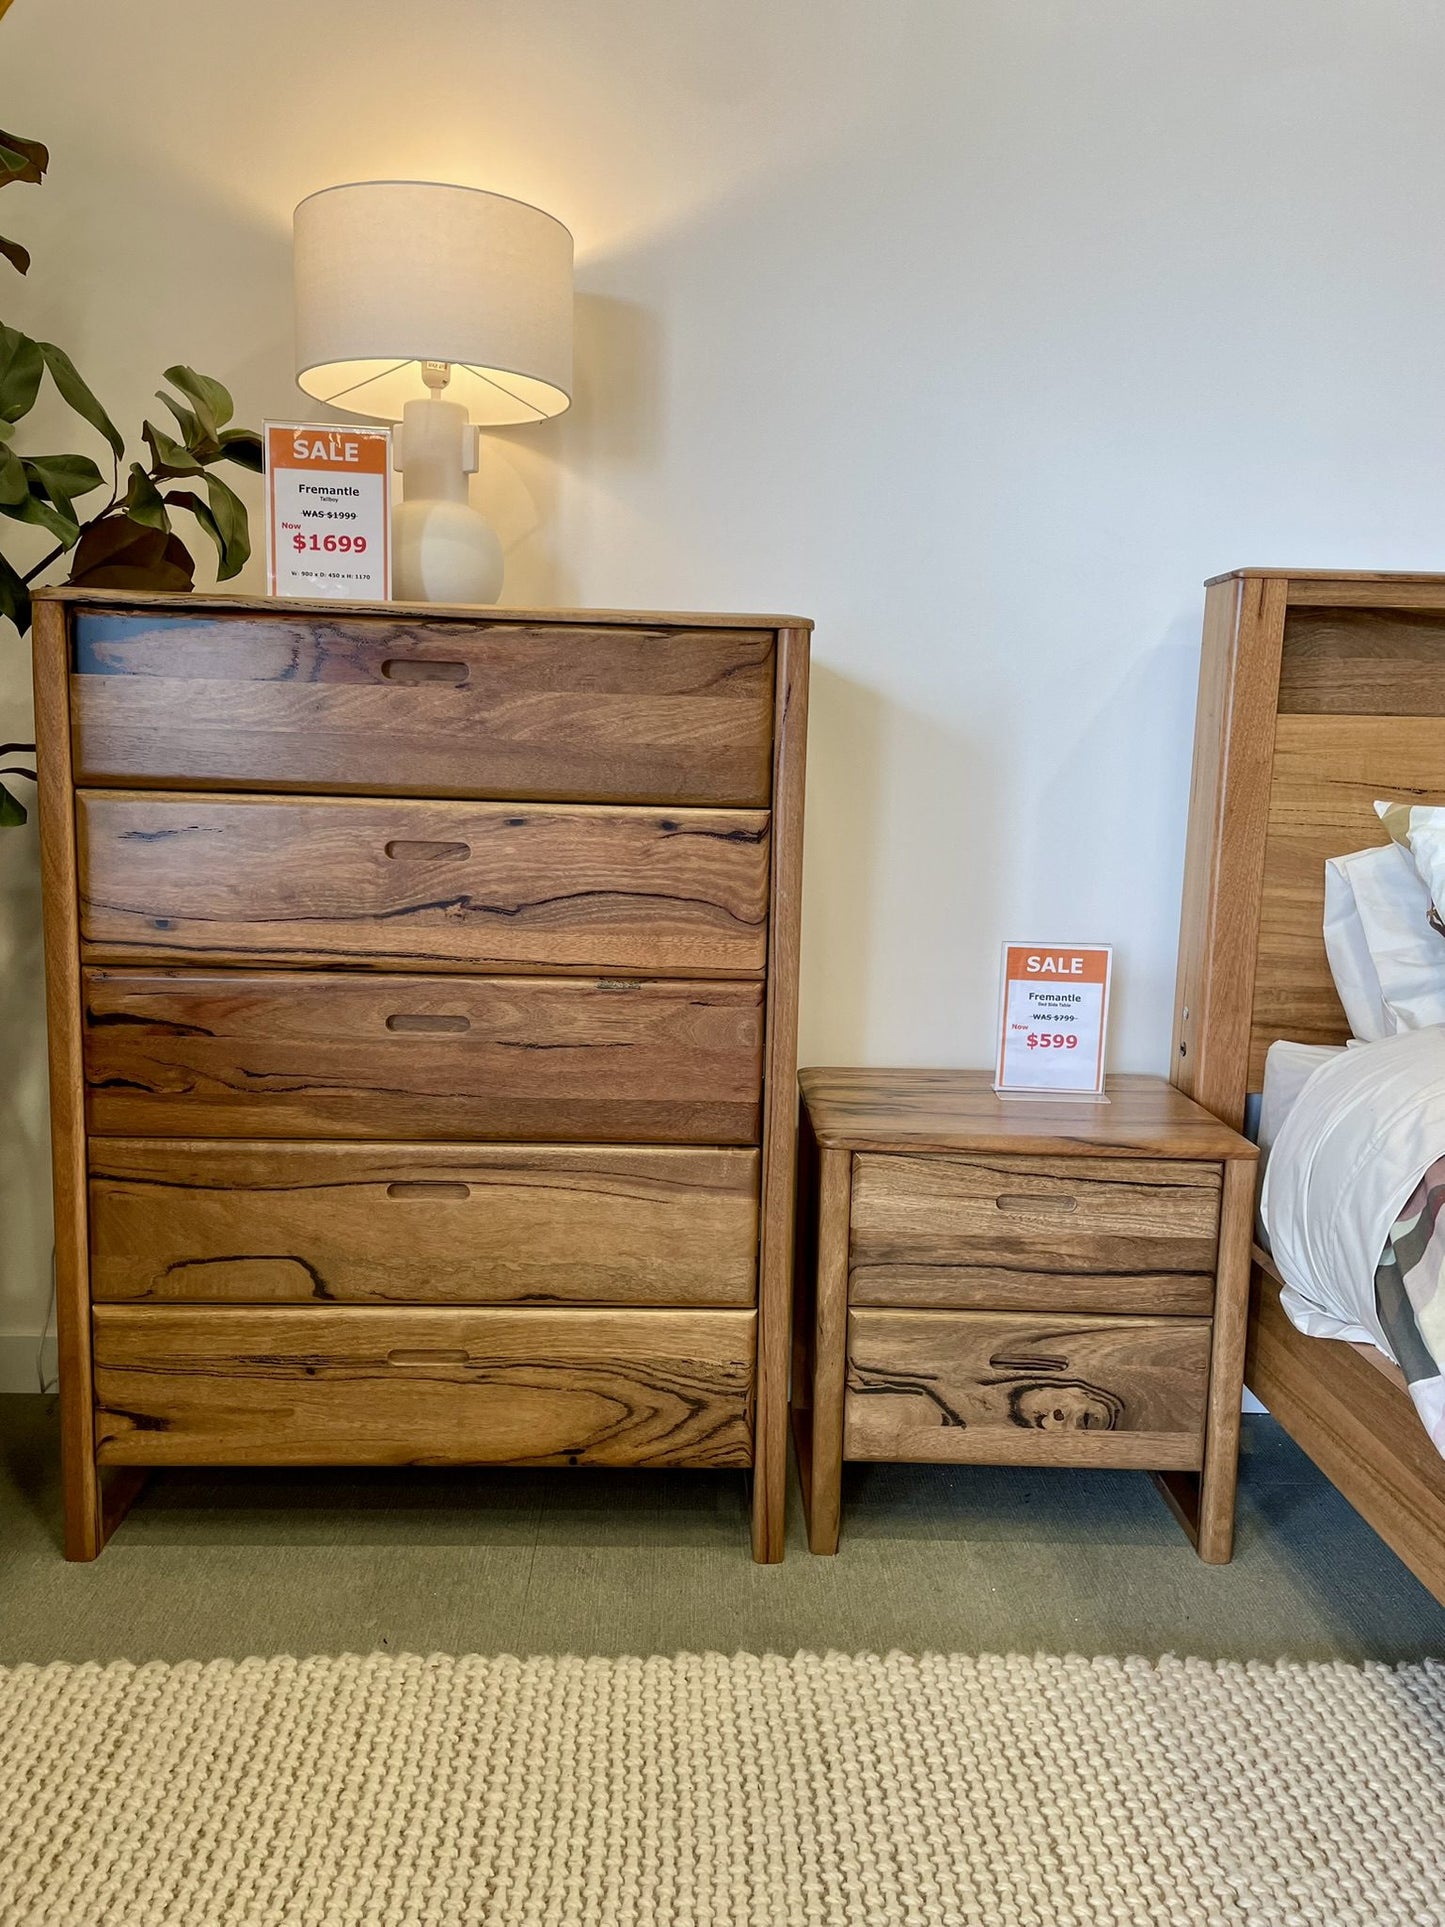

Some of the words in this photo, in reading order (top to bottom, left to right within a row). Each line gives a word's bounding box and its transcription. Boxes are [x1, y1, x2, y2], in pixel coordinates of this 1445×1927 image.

[293, 440, 359, 462] SALE
[299, 484, 360, 497] Fremantle
[302, 510, 324, 519] WAS
[327, 510, 357, 520] $1999
[281, 522, 301, 530] Now
[293, 532, 367, 553] $1699
[1026, 956, 1083, 974] SALE
[1028, 992, 1081, 1003] Fremantle
[1032, 1013, 1052, 1021] WAS
[1054, 1014, 1075, 1022] $799
[1026, 1032, 1078, 1050] $599
